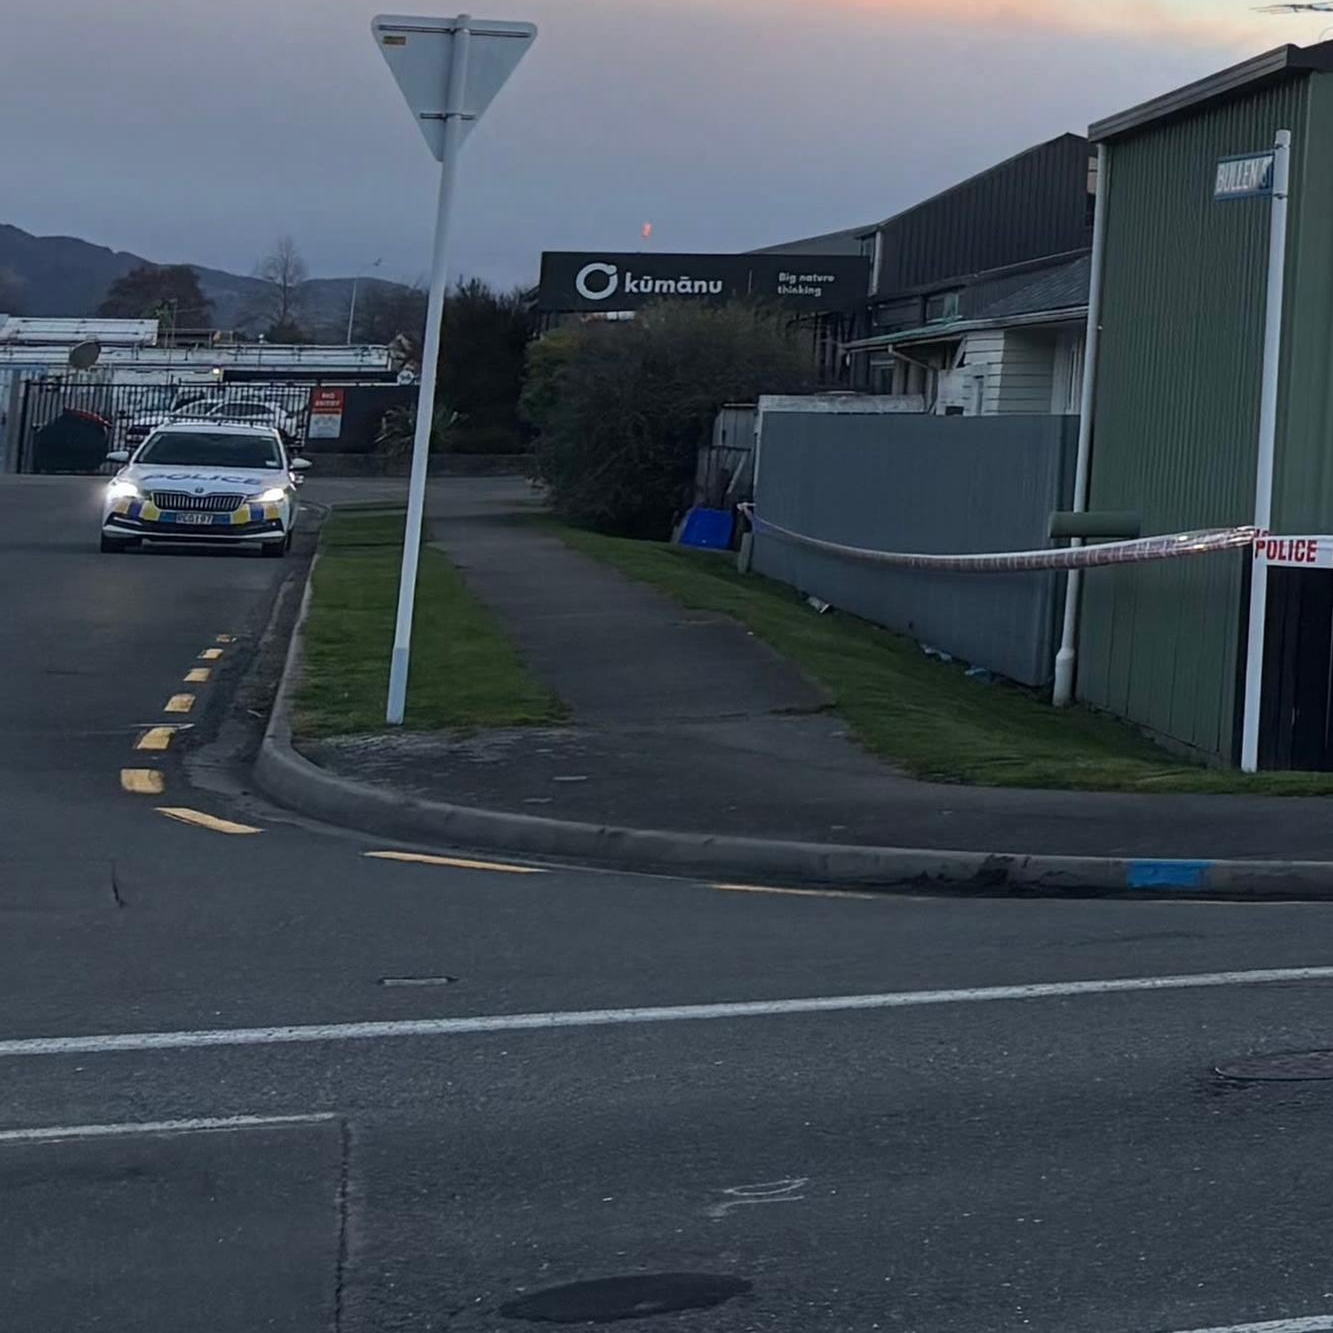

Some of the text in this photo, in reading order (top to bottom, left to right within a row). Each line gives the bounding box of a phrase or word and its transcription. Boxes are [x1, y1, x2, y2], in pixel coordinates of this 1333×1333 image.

[624, 272, 723, 294] kūmānu
[779, 272, 796, 284] Big
[778, 284, 822, 297] thinking
[143, 473, 261, 485] POLICE
[1255, 538, 1318, 563] POLICE
